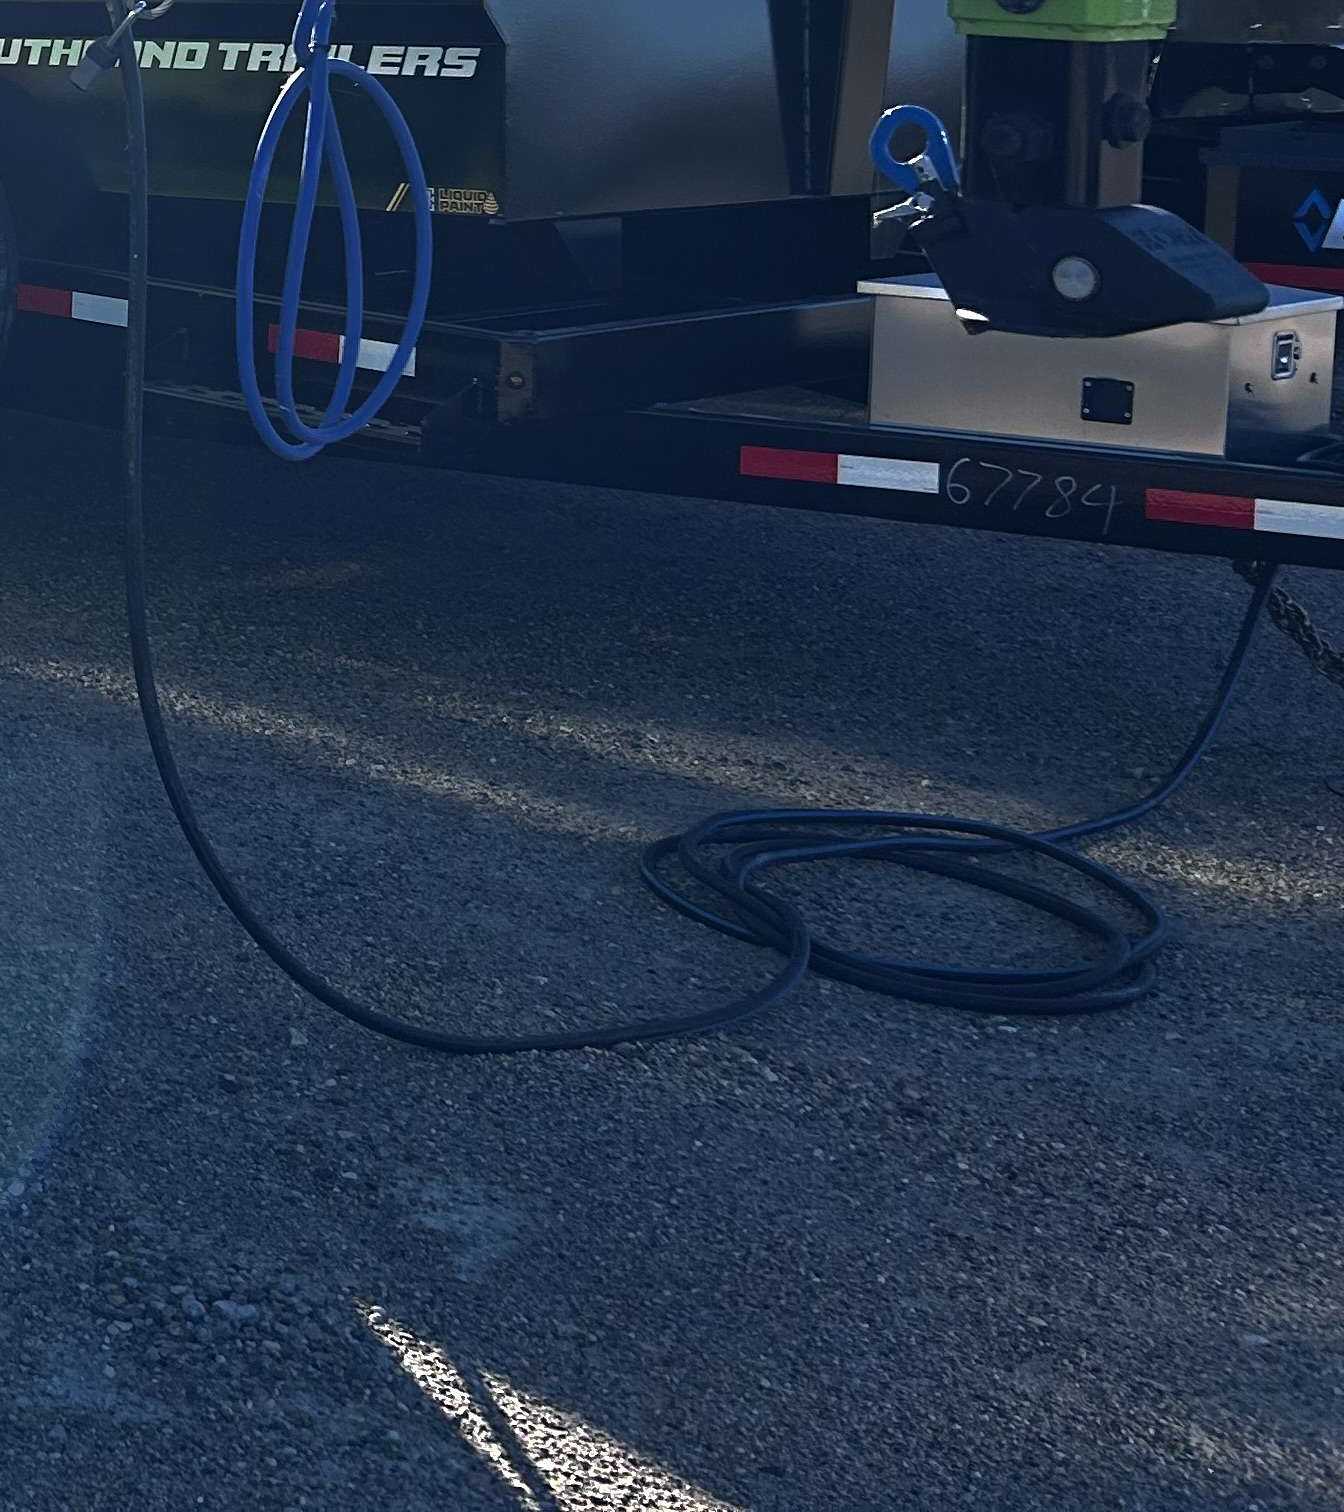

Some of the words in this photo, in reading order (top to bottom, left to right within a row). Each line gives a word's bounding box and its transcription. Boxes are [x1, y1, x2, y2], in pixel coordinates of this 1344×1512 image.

[438, 188, 487, 201] LIQUID
[439, 200, 484, 214] PAINT
[946, 457, 1122, 535] 67784
